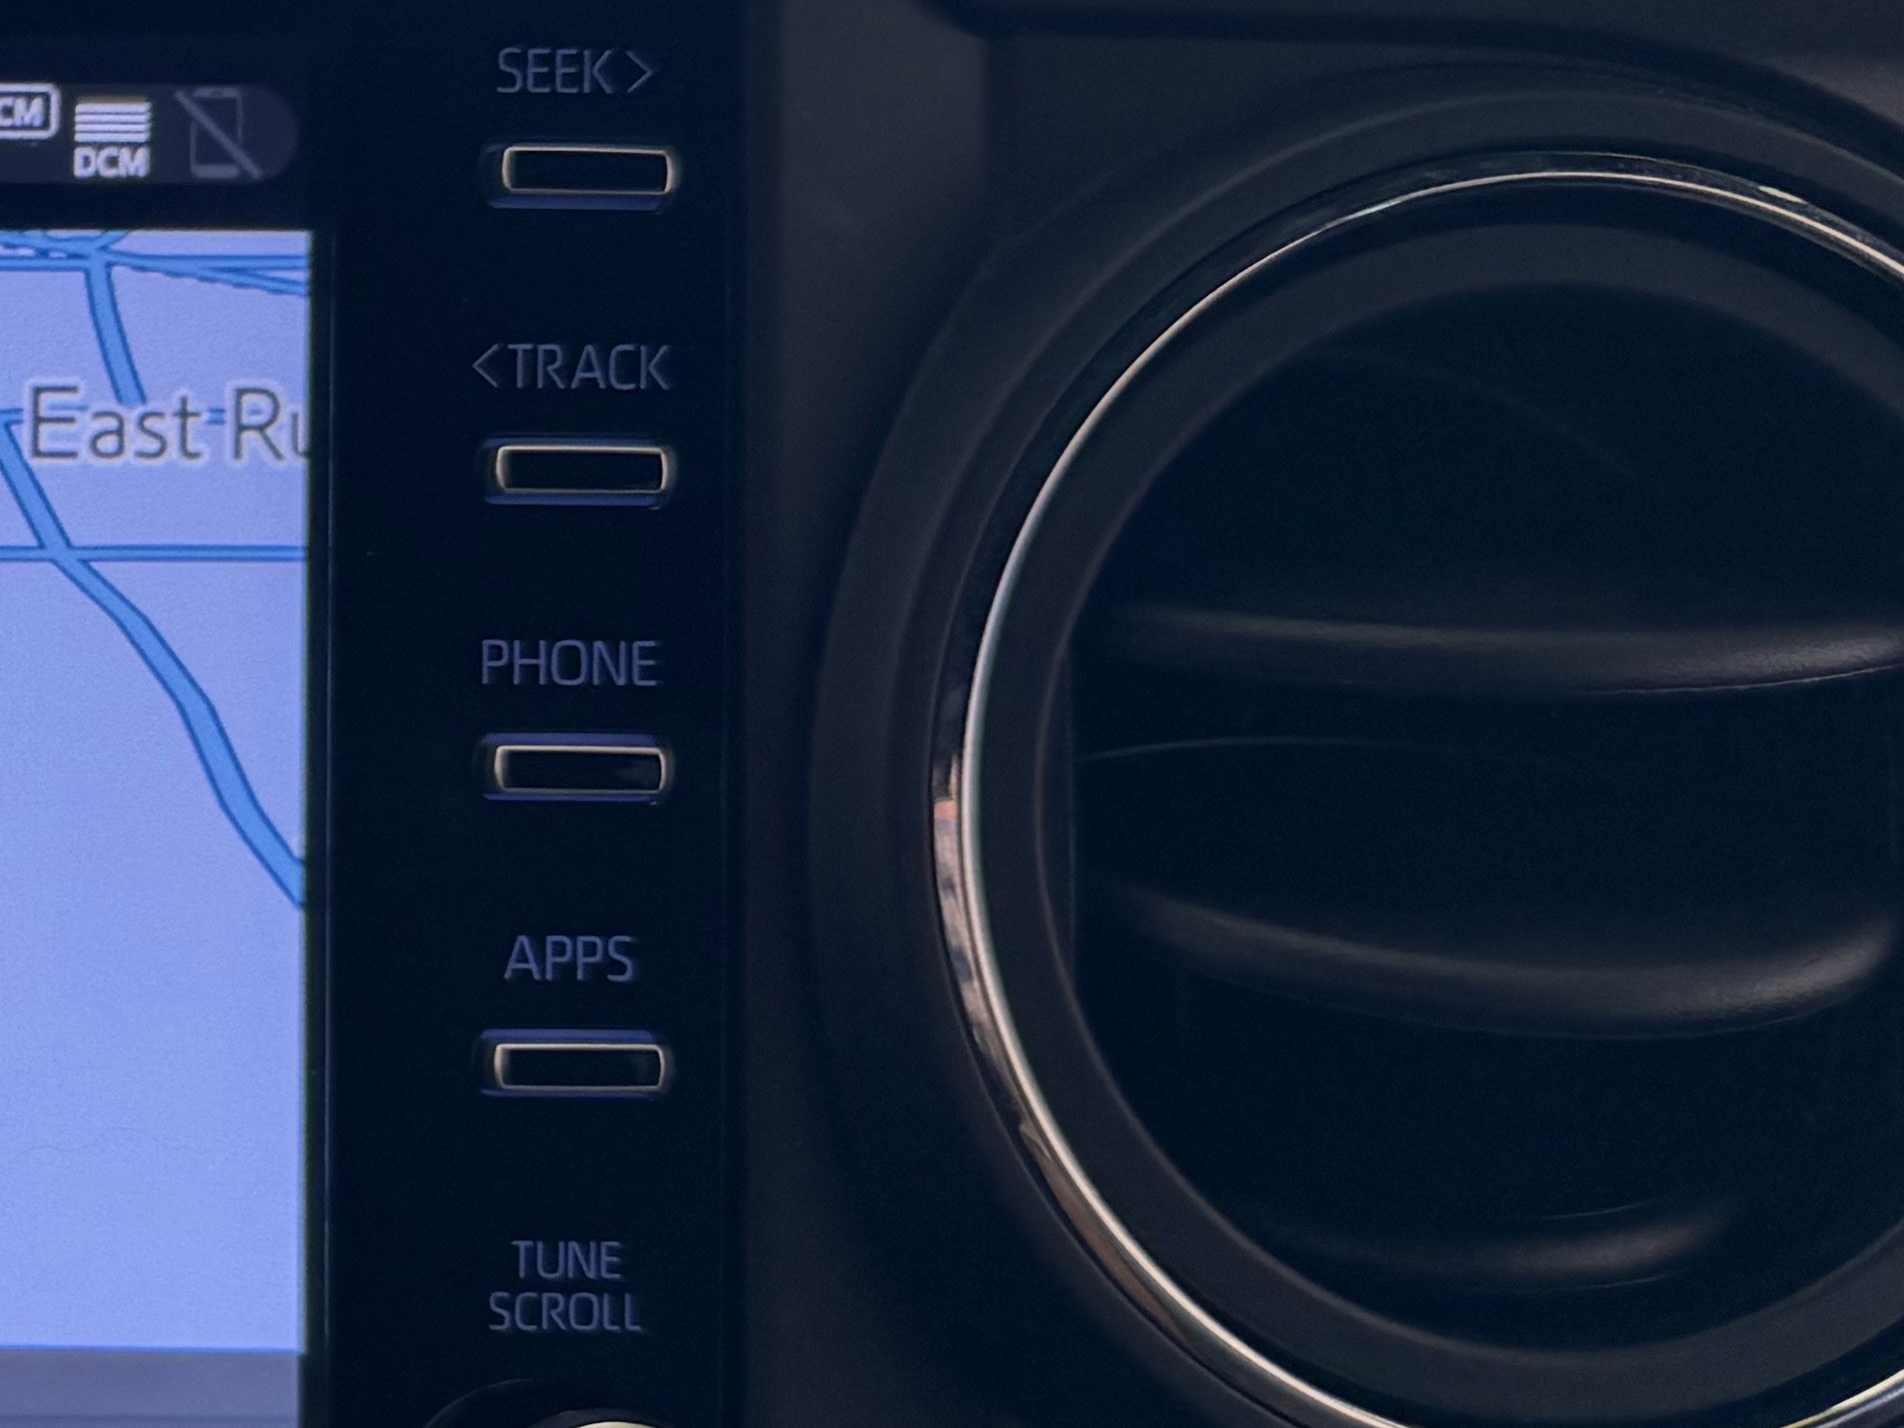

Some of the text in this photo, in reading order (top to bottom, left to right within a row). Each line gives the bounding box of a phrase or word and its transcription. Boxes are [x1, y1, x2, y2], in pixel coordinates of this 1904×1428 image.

[74, 145, 149, 179] DCM
[30, 384, 206, 460] East
[480, 638, 660, 687] PHONE
[503, 934, 635, 983] APPS
[511, 1239, 623, 1281] TUNE
[488, 1291, 642, 1333] SCROLL
